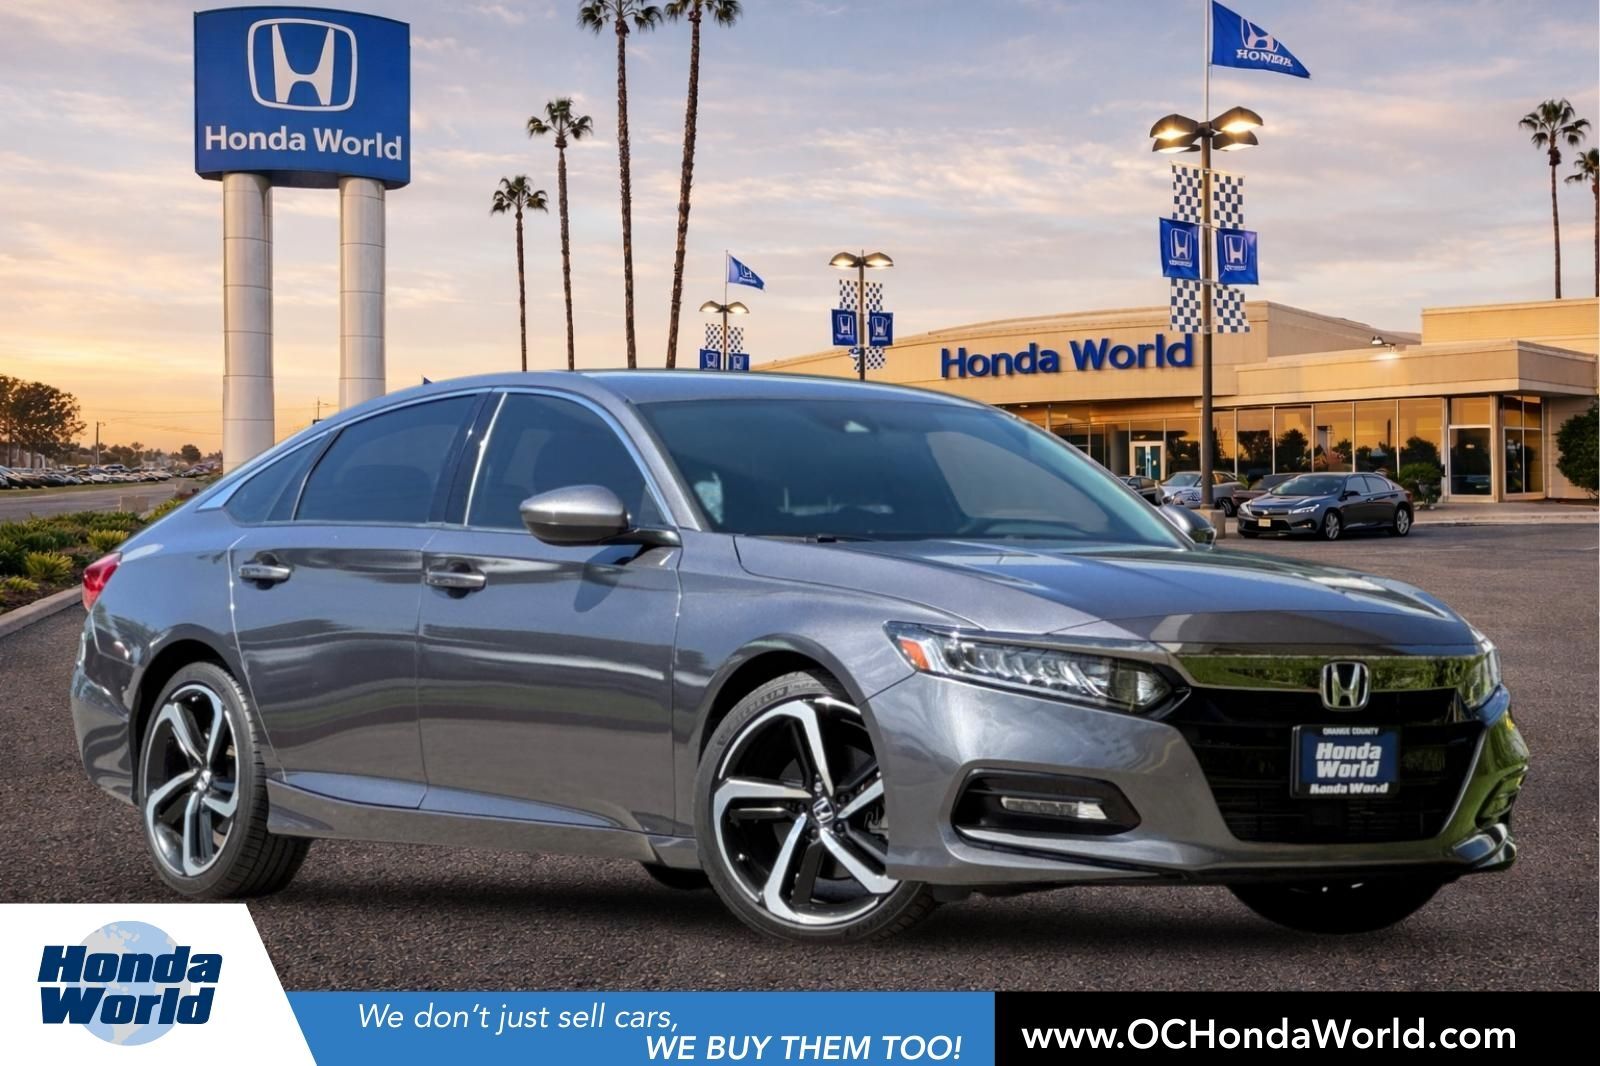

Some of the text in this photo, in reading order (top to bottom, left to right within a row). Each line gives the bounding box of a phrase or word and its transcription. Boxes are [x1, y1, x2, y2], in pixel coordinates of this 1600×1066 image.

[205, 125, 403, 161] Honda World
[941, 332, 1194, 378] Honda World
[1351, 727, 1379, 736] COUNTY
[1315, 741, 1383, 760] Honda
[1316, 760, 1380, 778] World
